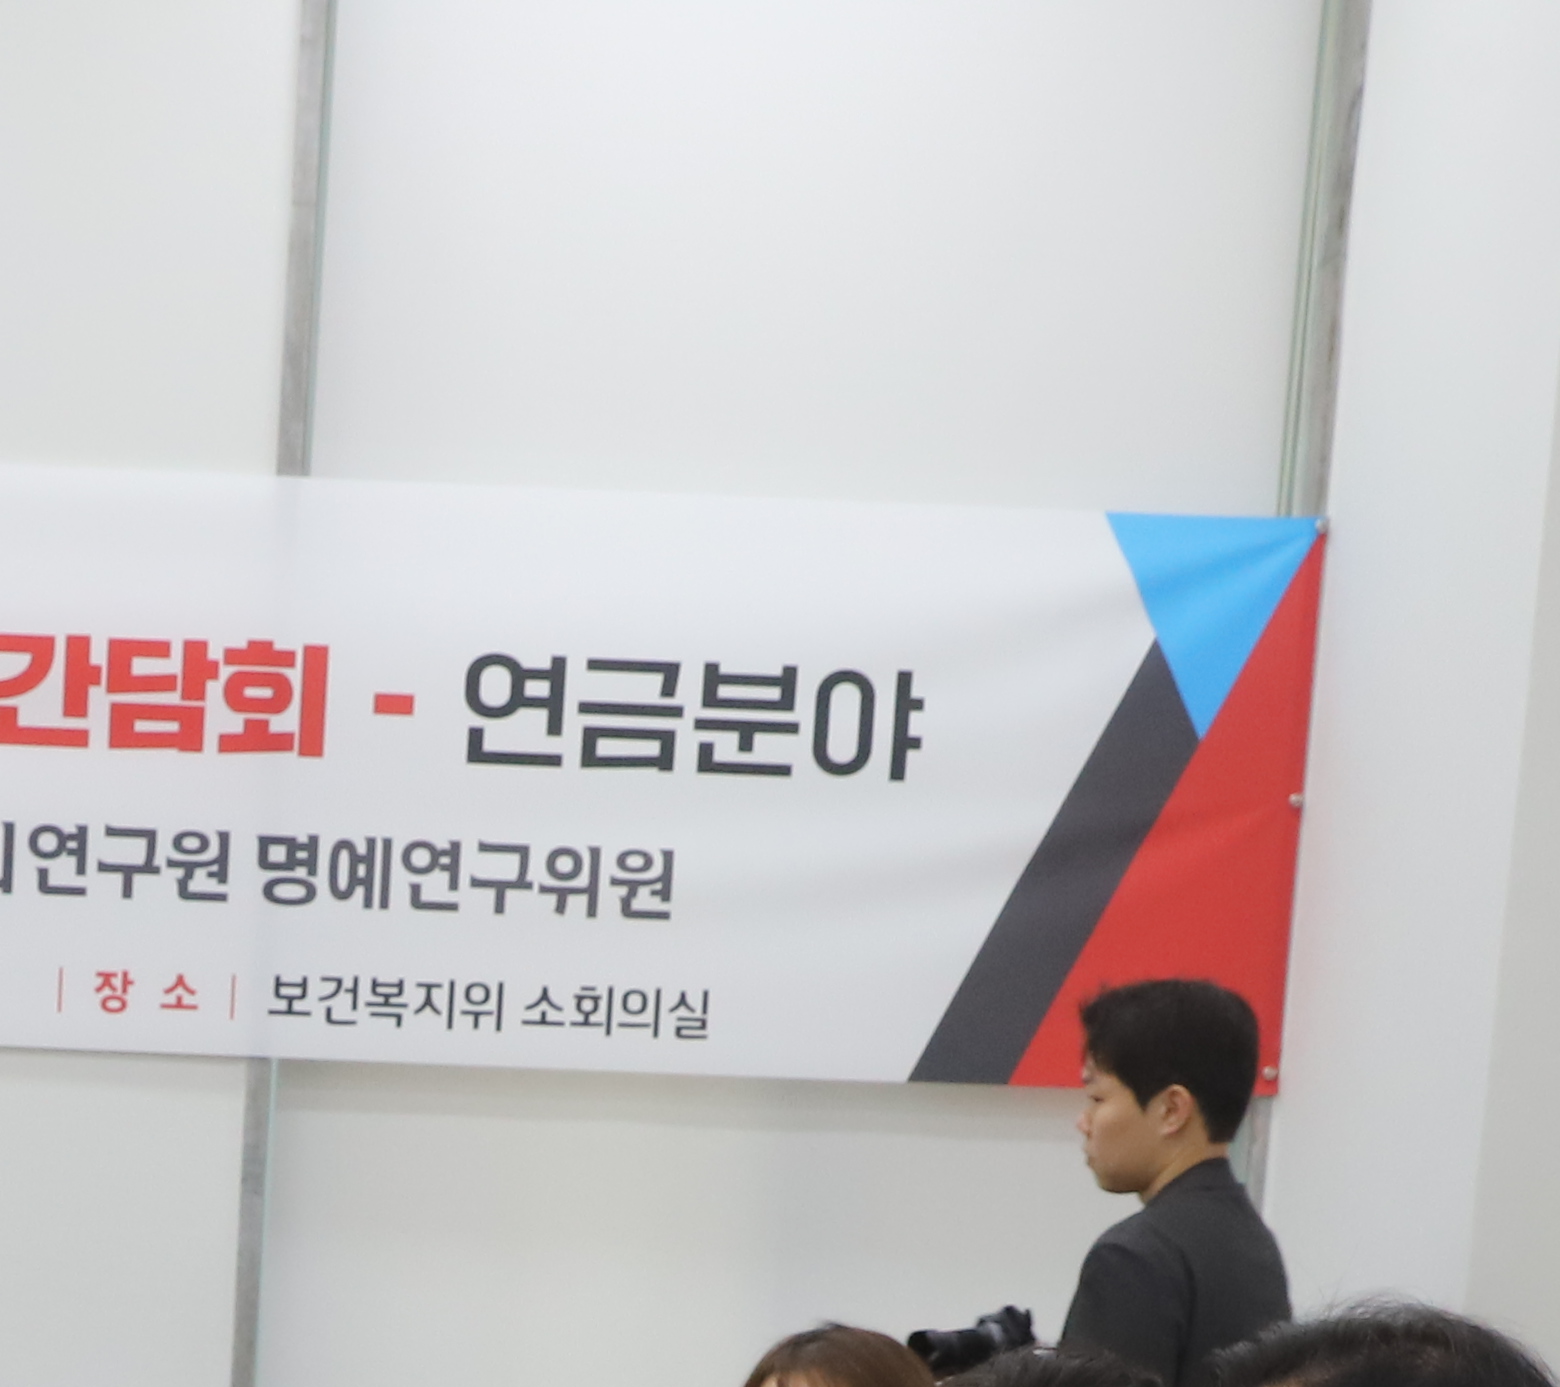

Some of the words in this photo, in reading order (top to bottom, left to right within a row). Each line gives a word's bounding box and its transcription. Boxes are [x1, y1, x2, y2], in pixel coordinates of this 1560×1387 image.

[372, 691, 415, 716] -
[464, 651, 924, 782] 연금분야
[255, 833, 676, 921] 명예연구위원
[266, 972, 507, 1033] 보건복지위
[521, 985, 712, 1041] 소회의실
